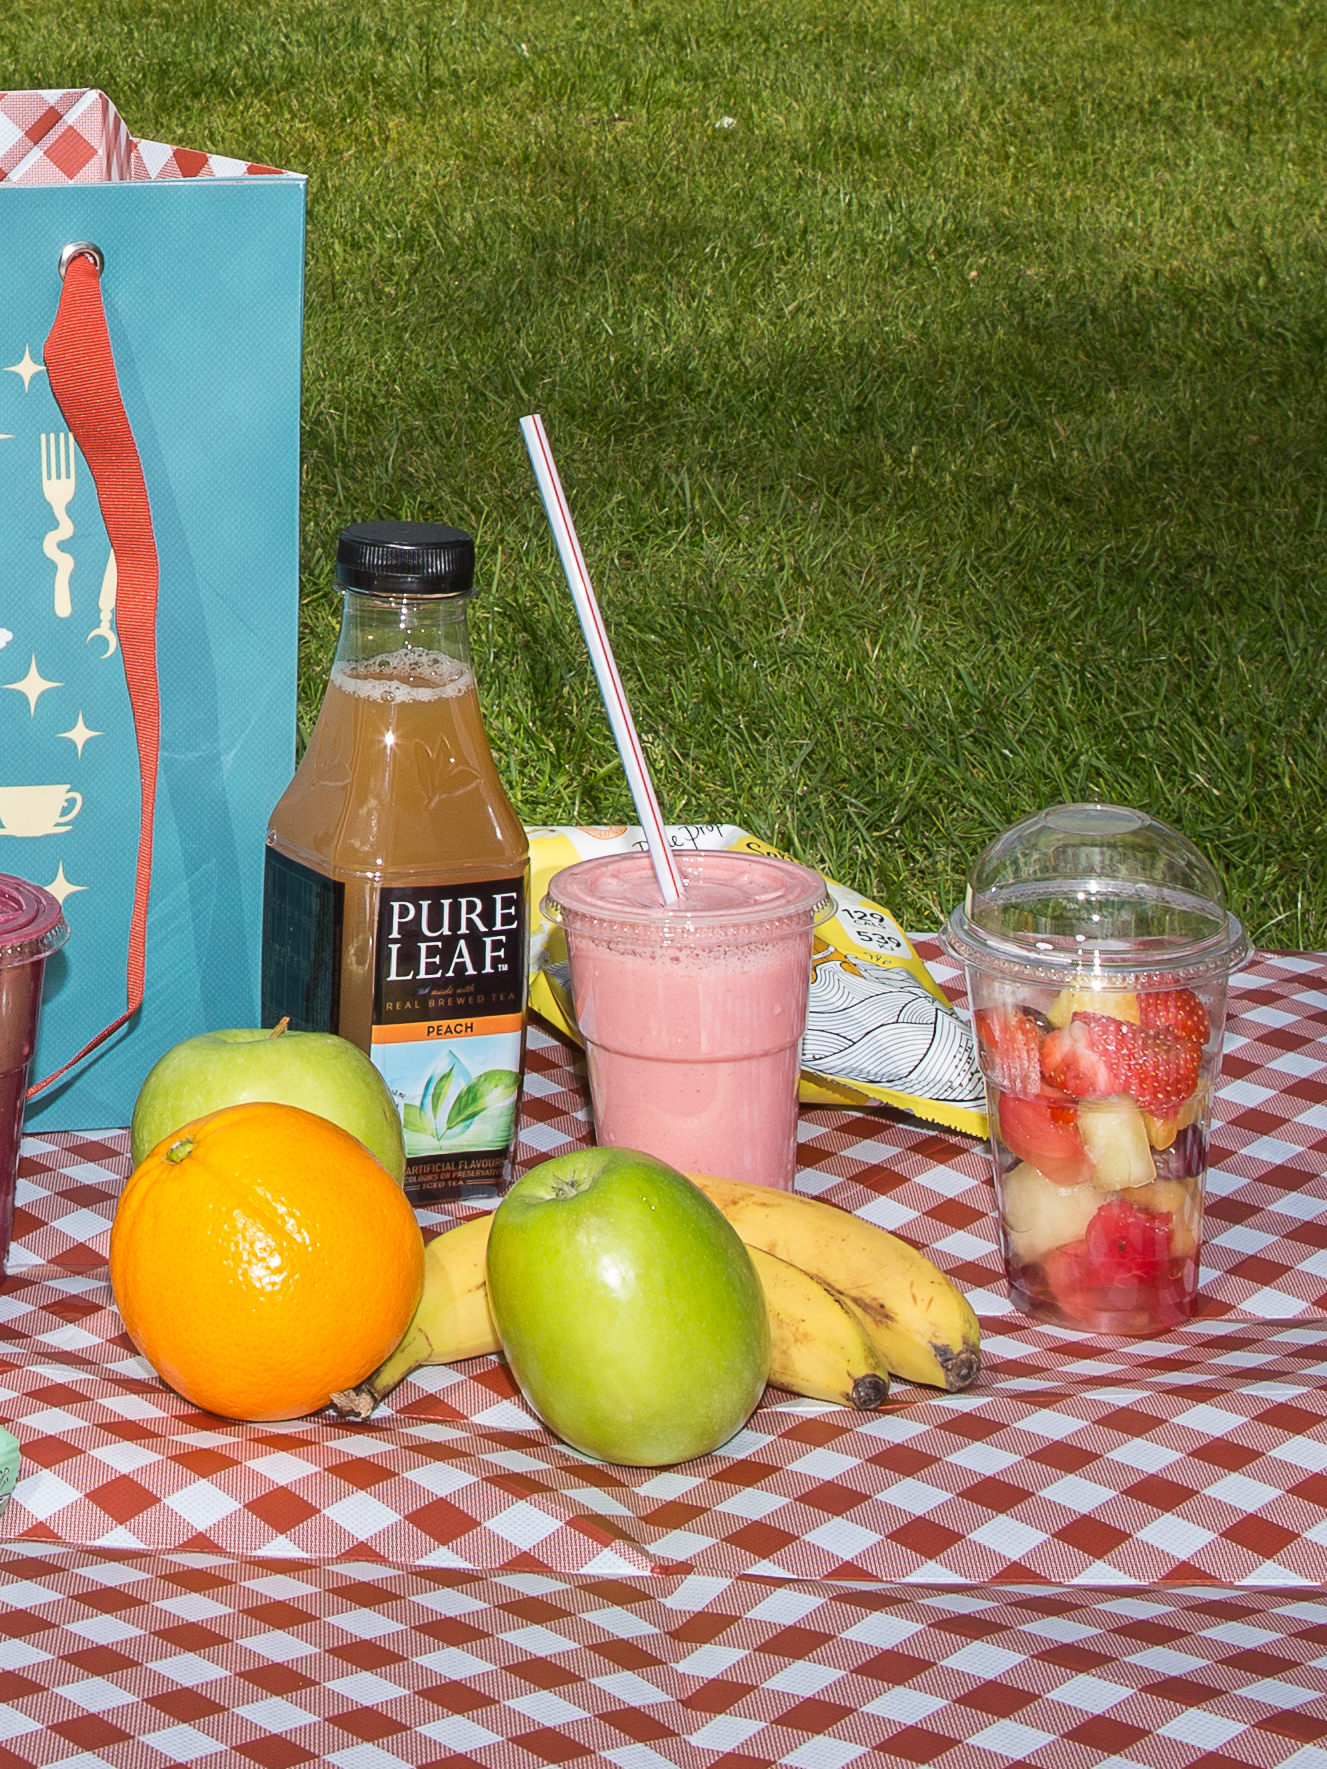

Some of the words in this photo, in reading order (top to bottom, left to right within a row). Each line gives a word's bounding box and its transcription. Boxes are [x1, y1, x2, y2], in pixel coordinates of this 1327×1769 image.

[388, 892, 517, 939] PURE
[841, 908, 885, 924] 129
[856, 930, 902, 949] 539
[386, 935, 507, 981] LEAF
[430, 985, 454, 996] made
[456, 982, 475, 994] with
[386, 1000, 421, 1011] REAL
[428, 995, 485, 1008] BREWED
[492, 992, 515, 1002] TEA
[427, 1022, 474, 1037] PEACH
[405, 1162, 456, 1175] ARTIFICIAL
[448, 1179, 464, 1188] TEA
